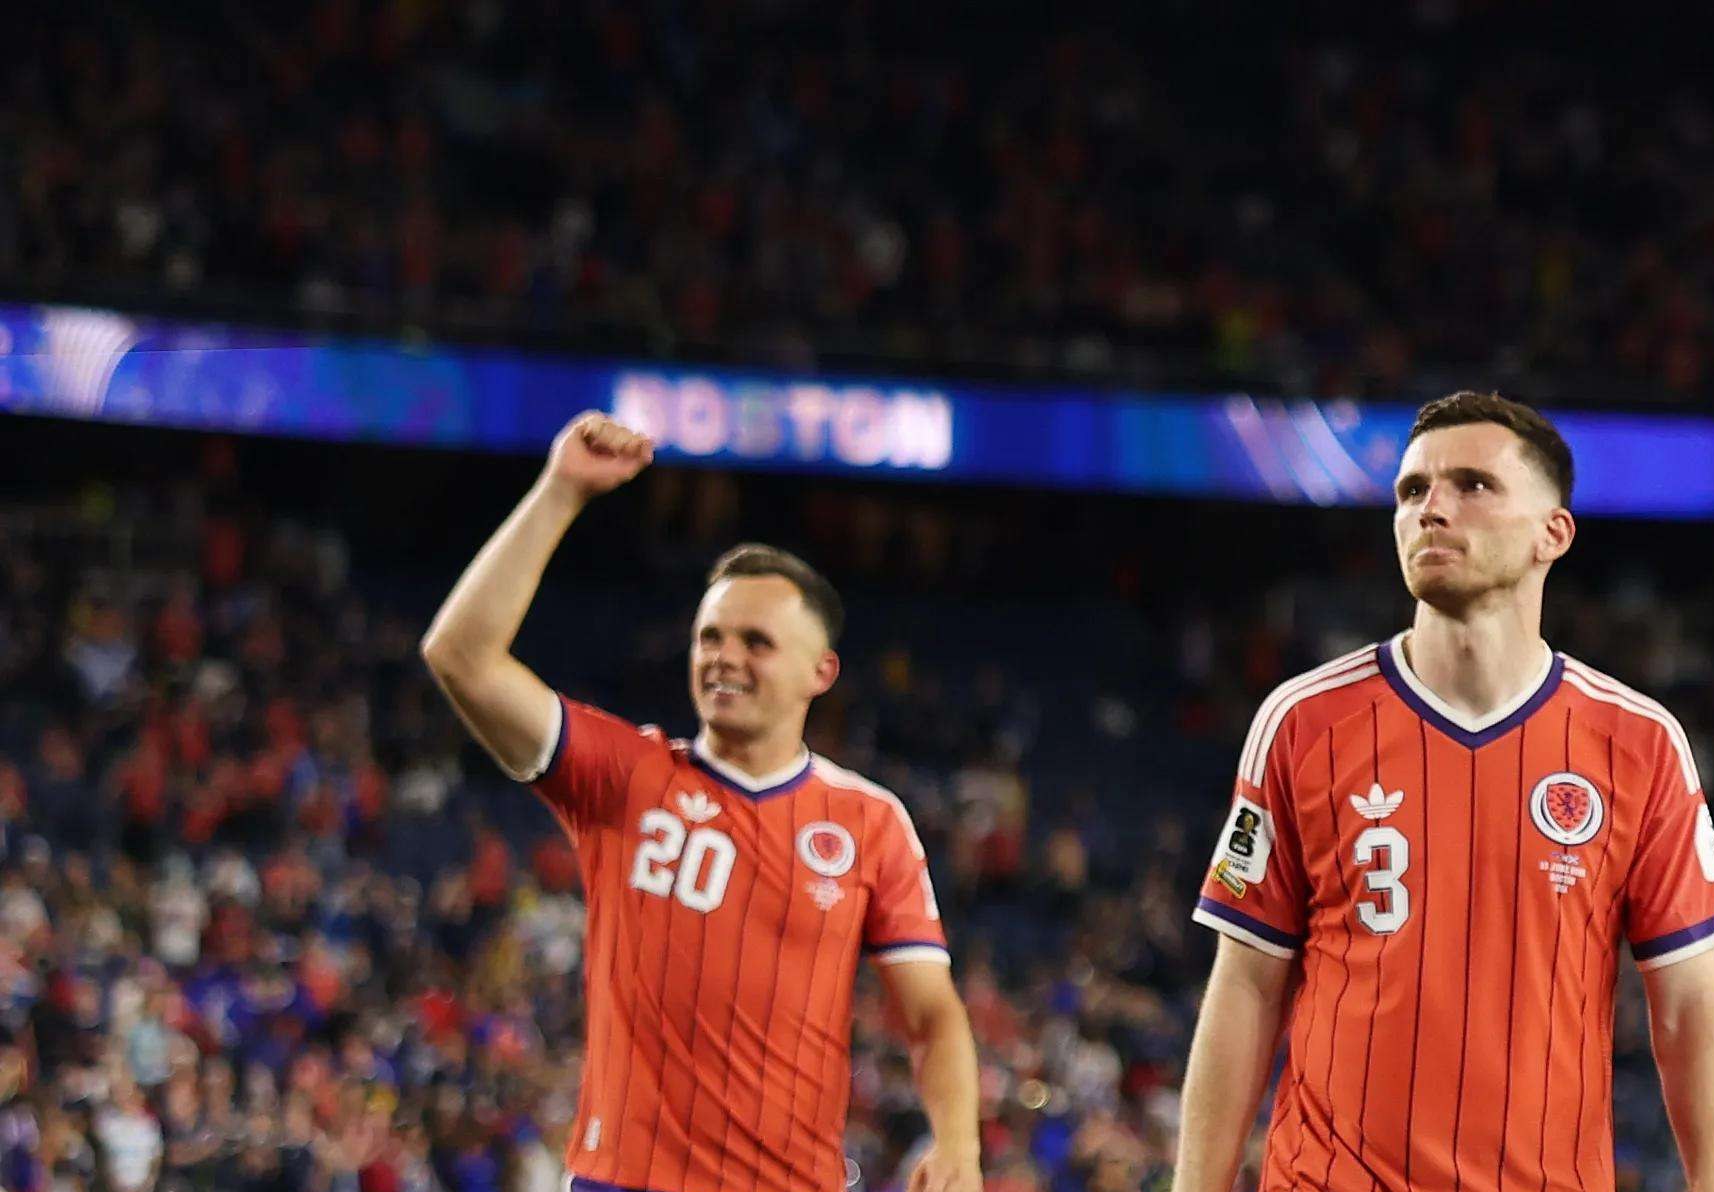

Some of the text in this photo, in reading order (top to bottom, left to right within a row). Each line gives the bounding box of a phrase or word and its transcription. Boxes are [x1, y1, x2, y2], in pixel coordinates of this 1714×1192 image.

[613, 373, 952, 469] BOSTON
[630, 808, 737, 914] 20
[1353, 826, 1411, 936] 3
